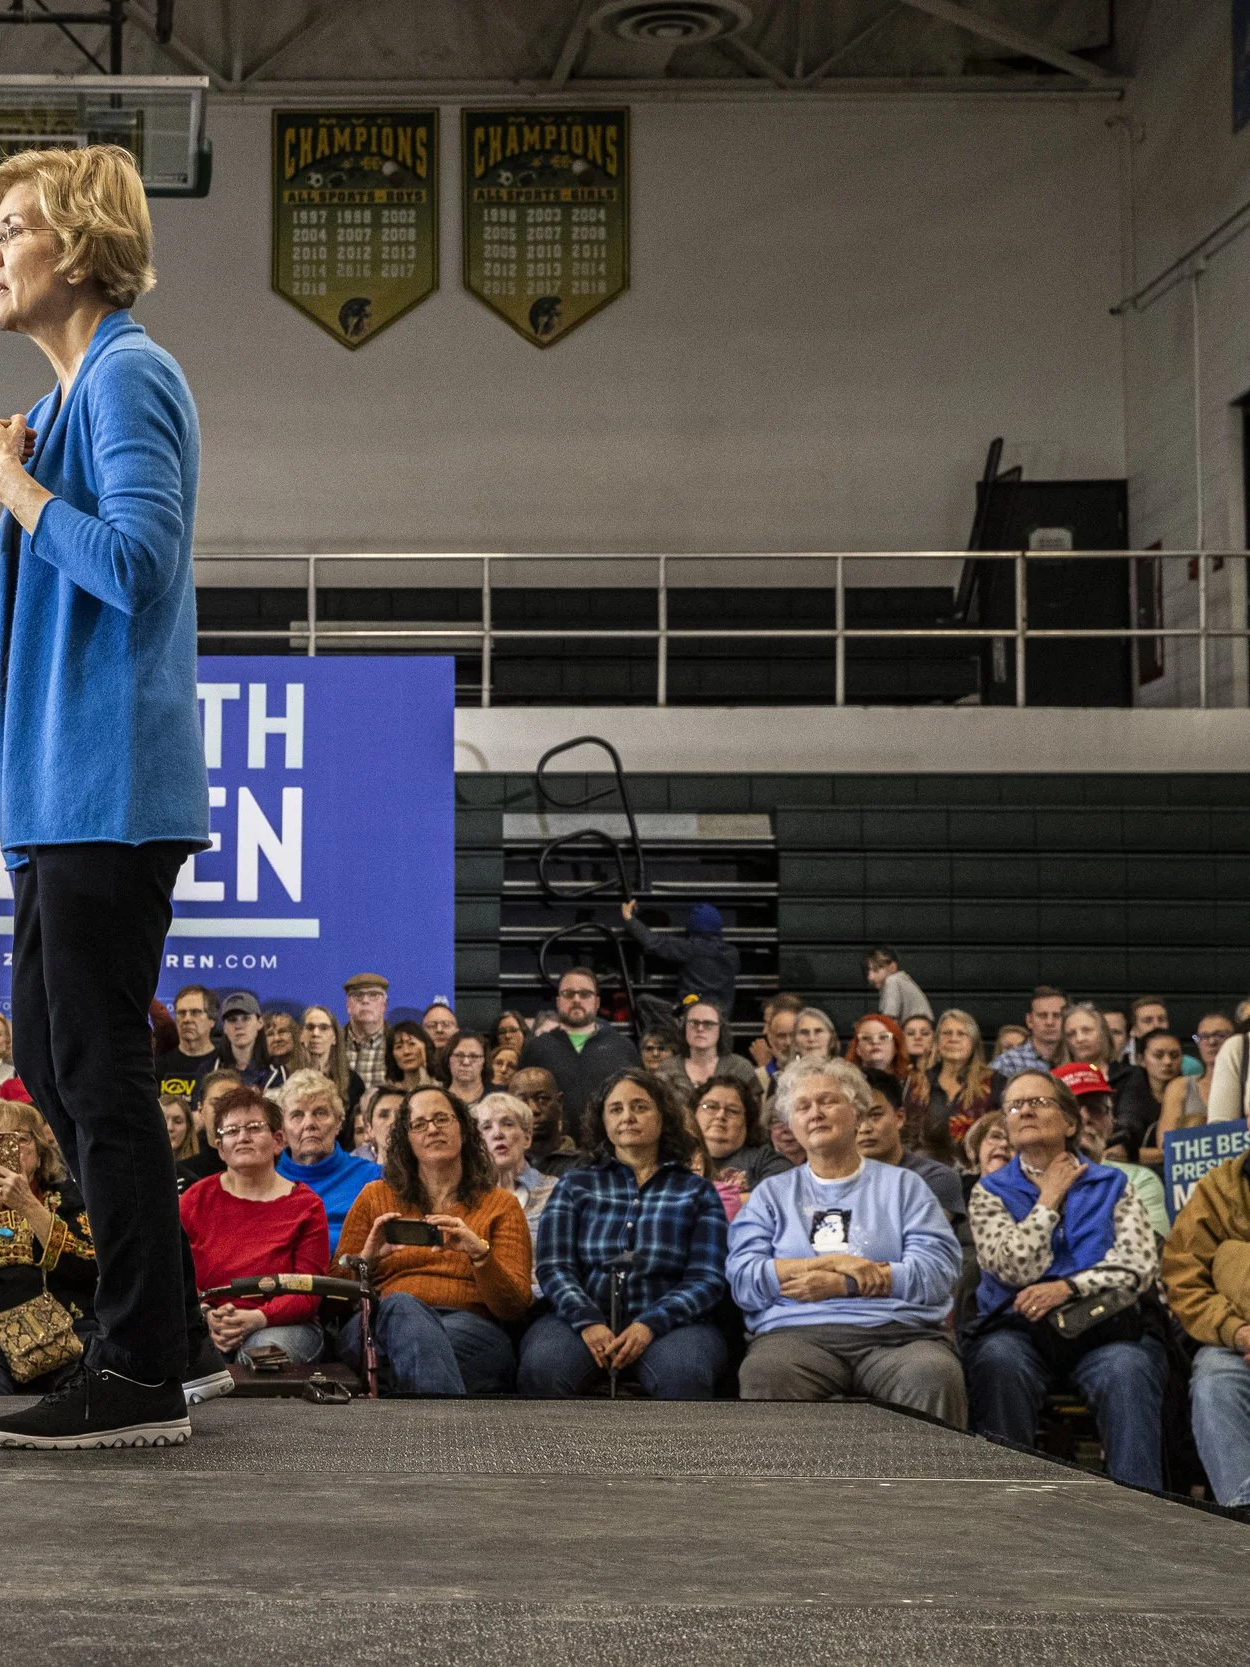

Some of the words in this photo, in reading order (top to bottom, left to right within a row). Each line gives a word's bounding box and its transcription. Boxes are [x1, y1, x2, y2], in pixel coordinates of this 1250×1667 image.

[284, 126, 428, 181] CHAMPIONS
[473, 124, 618, 179] CHAMPIONS
[287, 190, 316, 203] ALL
[319, 190, 375, 203] SPORTS
[387, 190, 424, 203] BOYS
[477, 189, 507, 202] ALL
[508, 189, 561, 202] SPORTS
[572, 189, 616, 202] GIRLS
[292, 209, 328, 224] 1997
[381, 209, 417, 224] 2002
[526, 208, 562, 224] 2003
[571, 208, 607, 224] 2004
[292, 227, 328, 243] 2004
[336, 227, 372, 243] 2007
[526, 225, 562, 242] 2007
[336, 245, 372, 261] 2012
[381, 245, 417, 261] 2013
[571, 244, 607, 260] 2011
[292, 263, 328, 279] 2014
[381, 263, 417, 279] 2017
[483, 262, 518, 278] 2012
[526, 262, 562, 278] 2013
[571, 262, 607, 278] 2014
[526, 280, 562, 296] 2017
[197, 683, 304, 769] TH
[1170, 1136, 1214, 1162] THE
